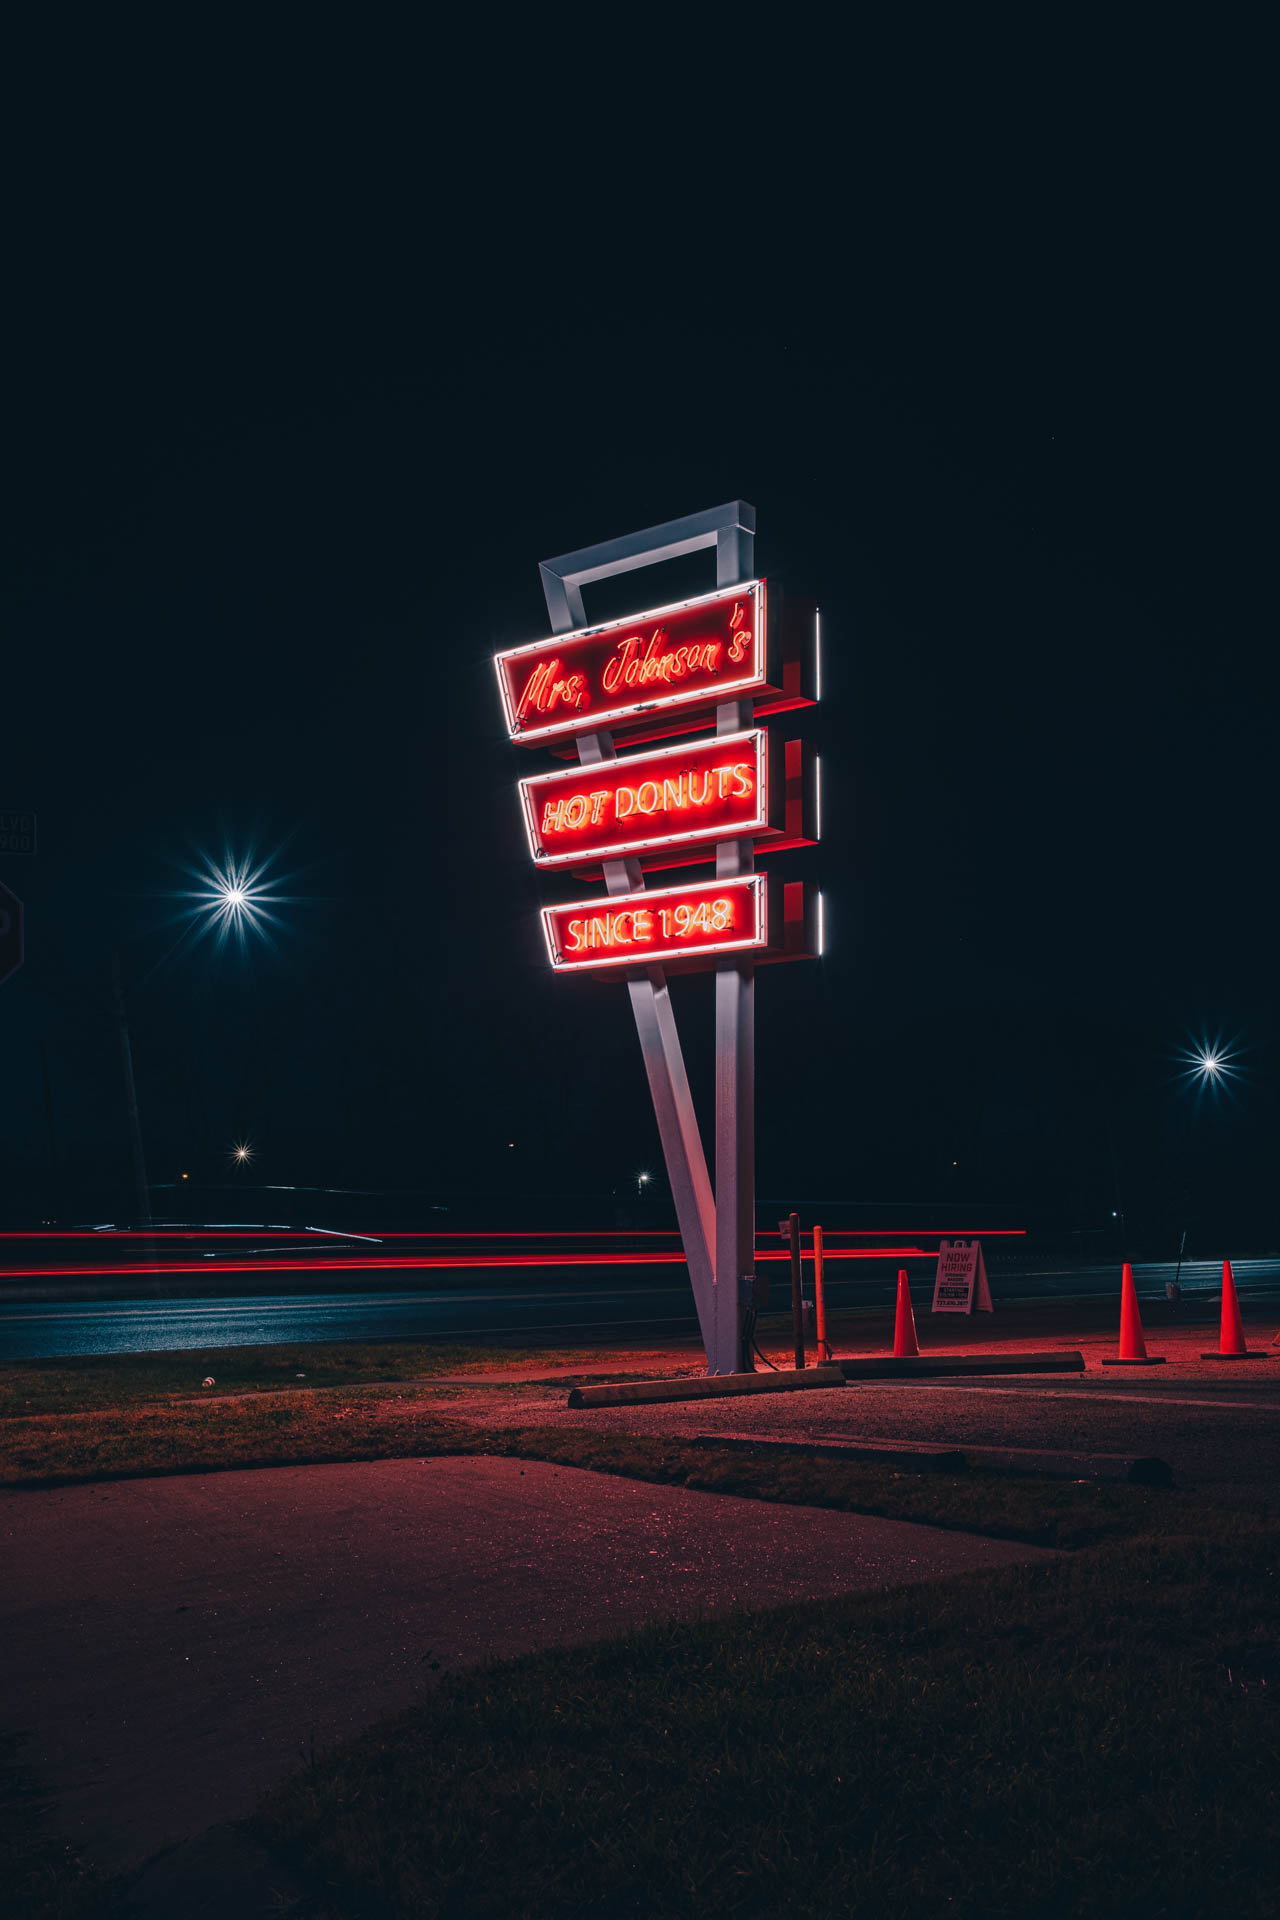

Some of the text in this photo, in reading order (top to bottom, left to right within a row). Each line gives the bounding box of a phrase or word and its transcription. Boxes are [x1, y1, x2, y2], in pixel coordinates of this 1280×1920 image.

[603, 602, 751, 690] Johnson's
[541, 763, 752, 834] HOT DONUTS
[565, 898, 730, 951] SINCE 1948
[941, 1263, 973, 1272] HIRING
[946, 1252, 970, 1262] NOW
